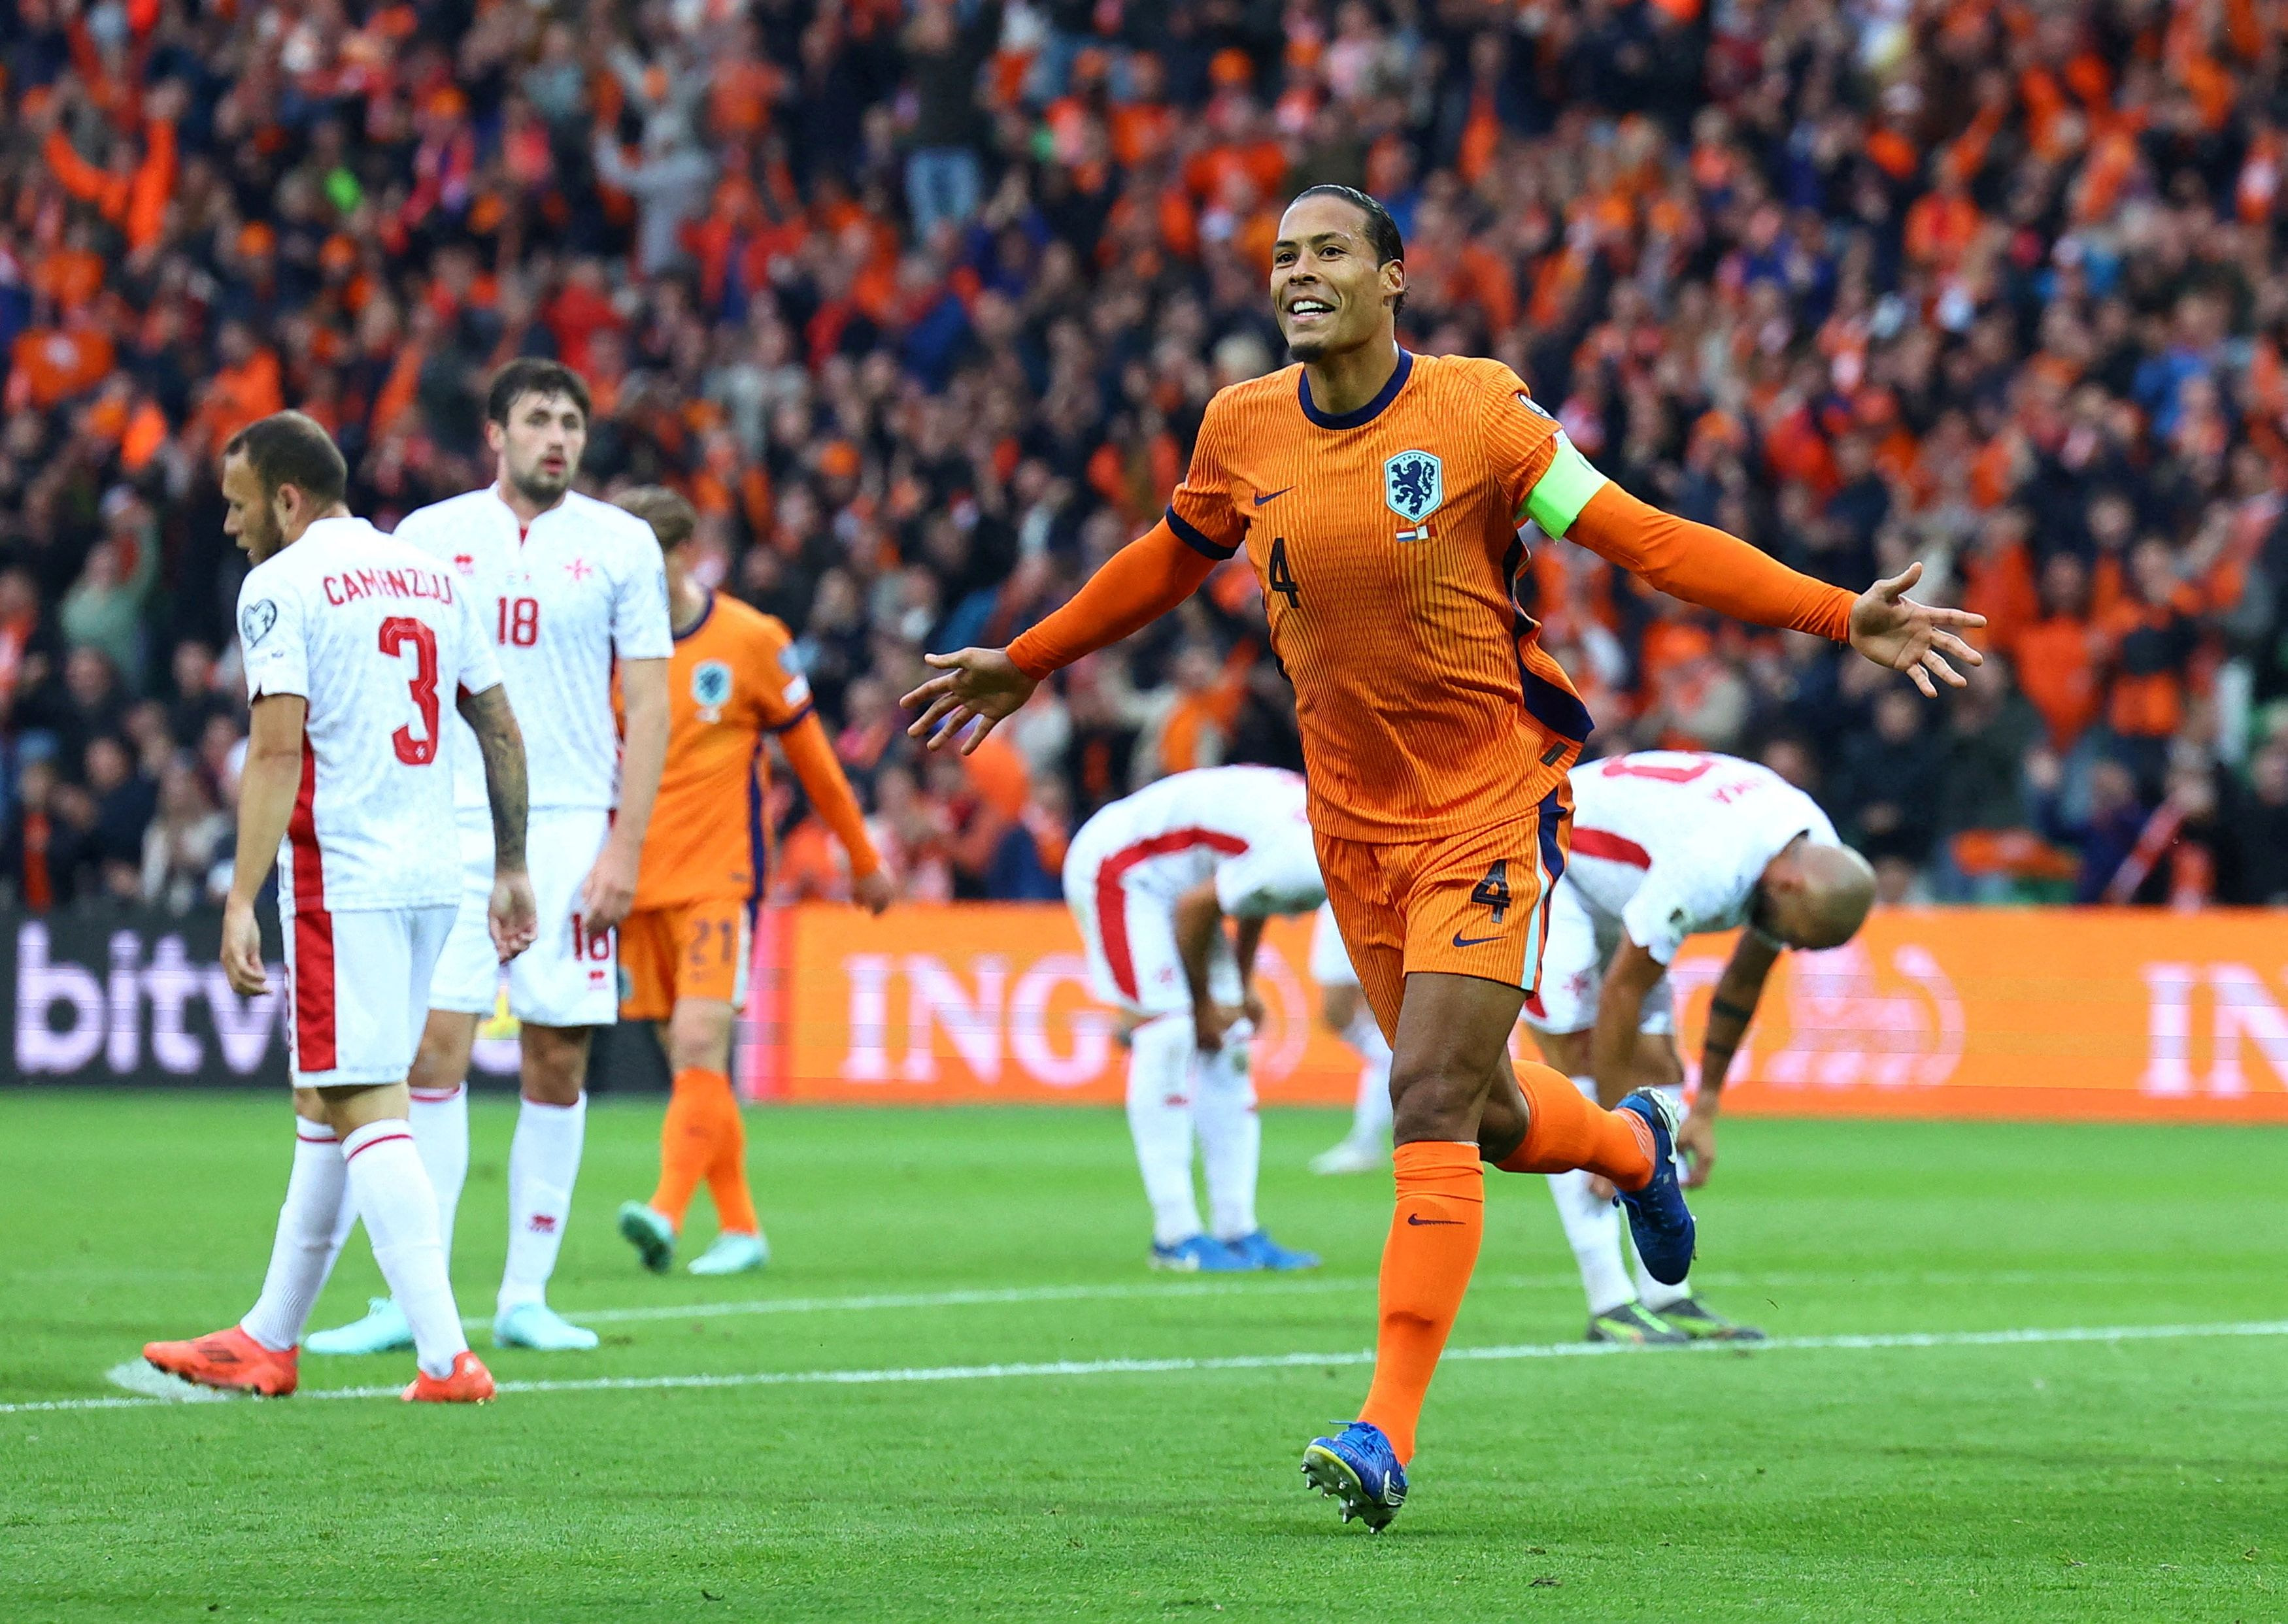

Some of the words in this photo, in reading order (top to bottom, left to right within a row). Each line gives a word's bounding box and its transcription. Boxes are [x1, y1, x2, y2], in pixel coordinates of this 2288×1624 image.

[1269, 537, 1299, 608] 4
[497, 597, 538, 646] 18
[379, 616, 439, 765] 3
[1471, 859, 1511, 923] 4
[689, 918, 733, 964] 21
[841, 952, 1113, 1086] ING
